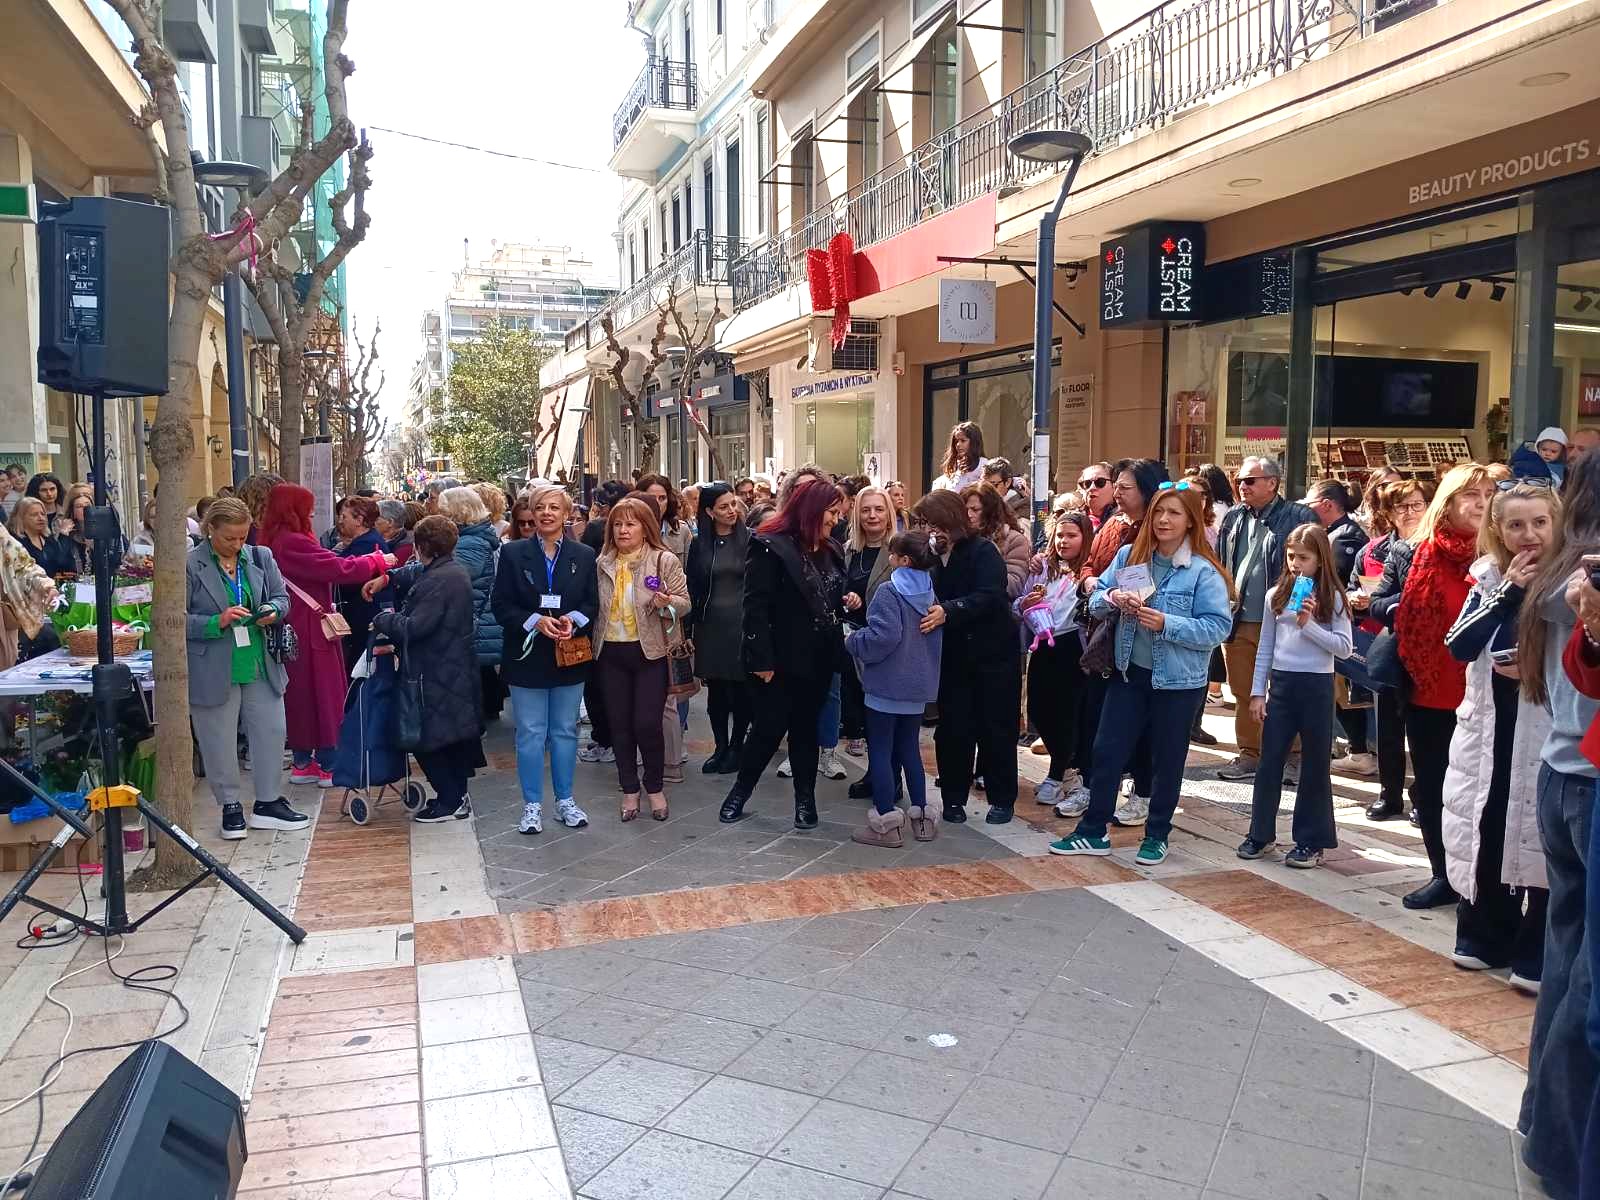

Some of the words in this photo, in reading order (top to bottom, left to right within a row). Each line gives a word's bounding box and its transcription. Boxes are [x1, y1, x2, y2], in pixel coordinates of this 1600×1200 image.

[1408, 169, 1477, 204] BEAUTY
[1480, 139, 1591, 186] PRODUCTS
[1104, 268, 1114, 320] DUST
[1114, 246, 1125, 318] CREAM
[1160, 256, 1175, 312] DUST
[1177, 238, 1192, 312] CREAM
[1069, 383, 1090, 393] FLOOR
